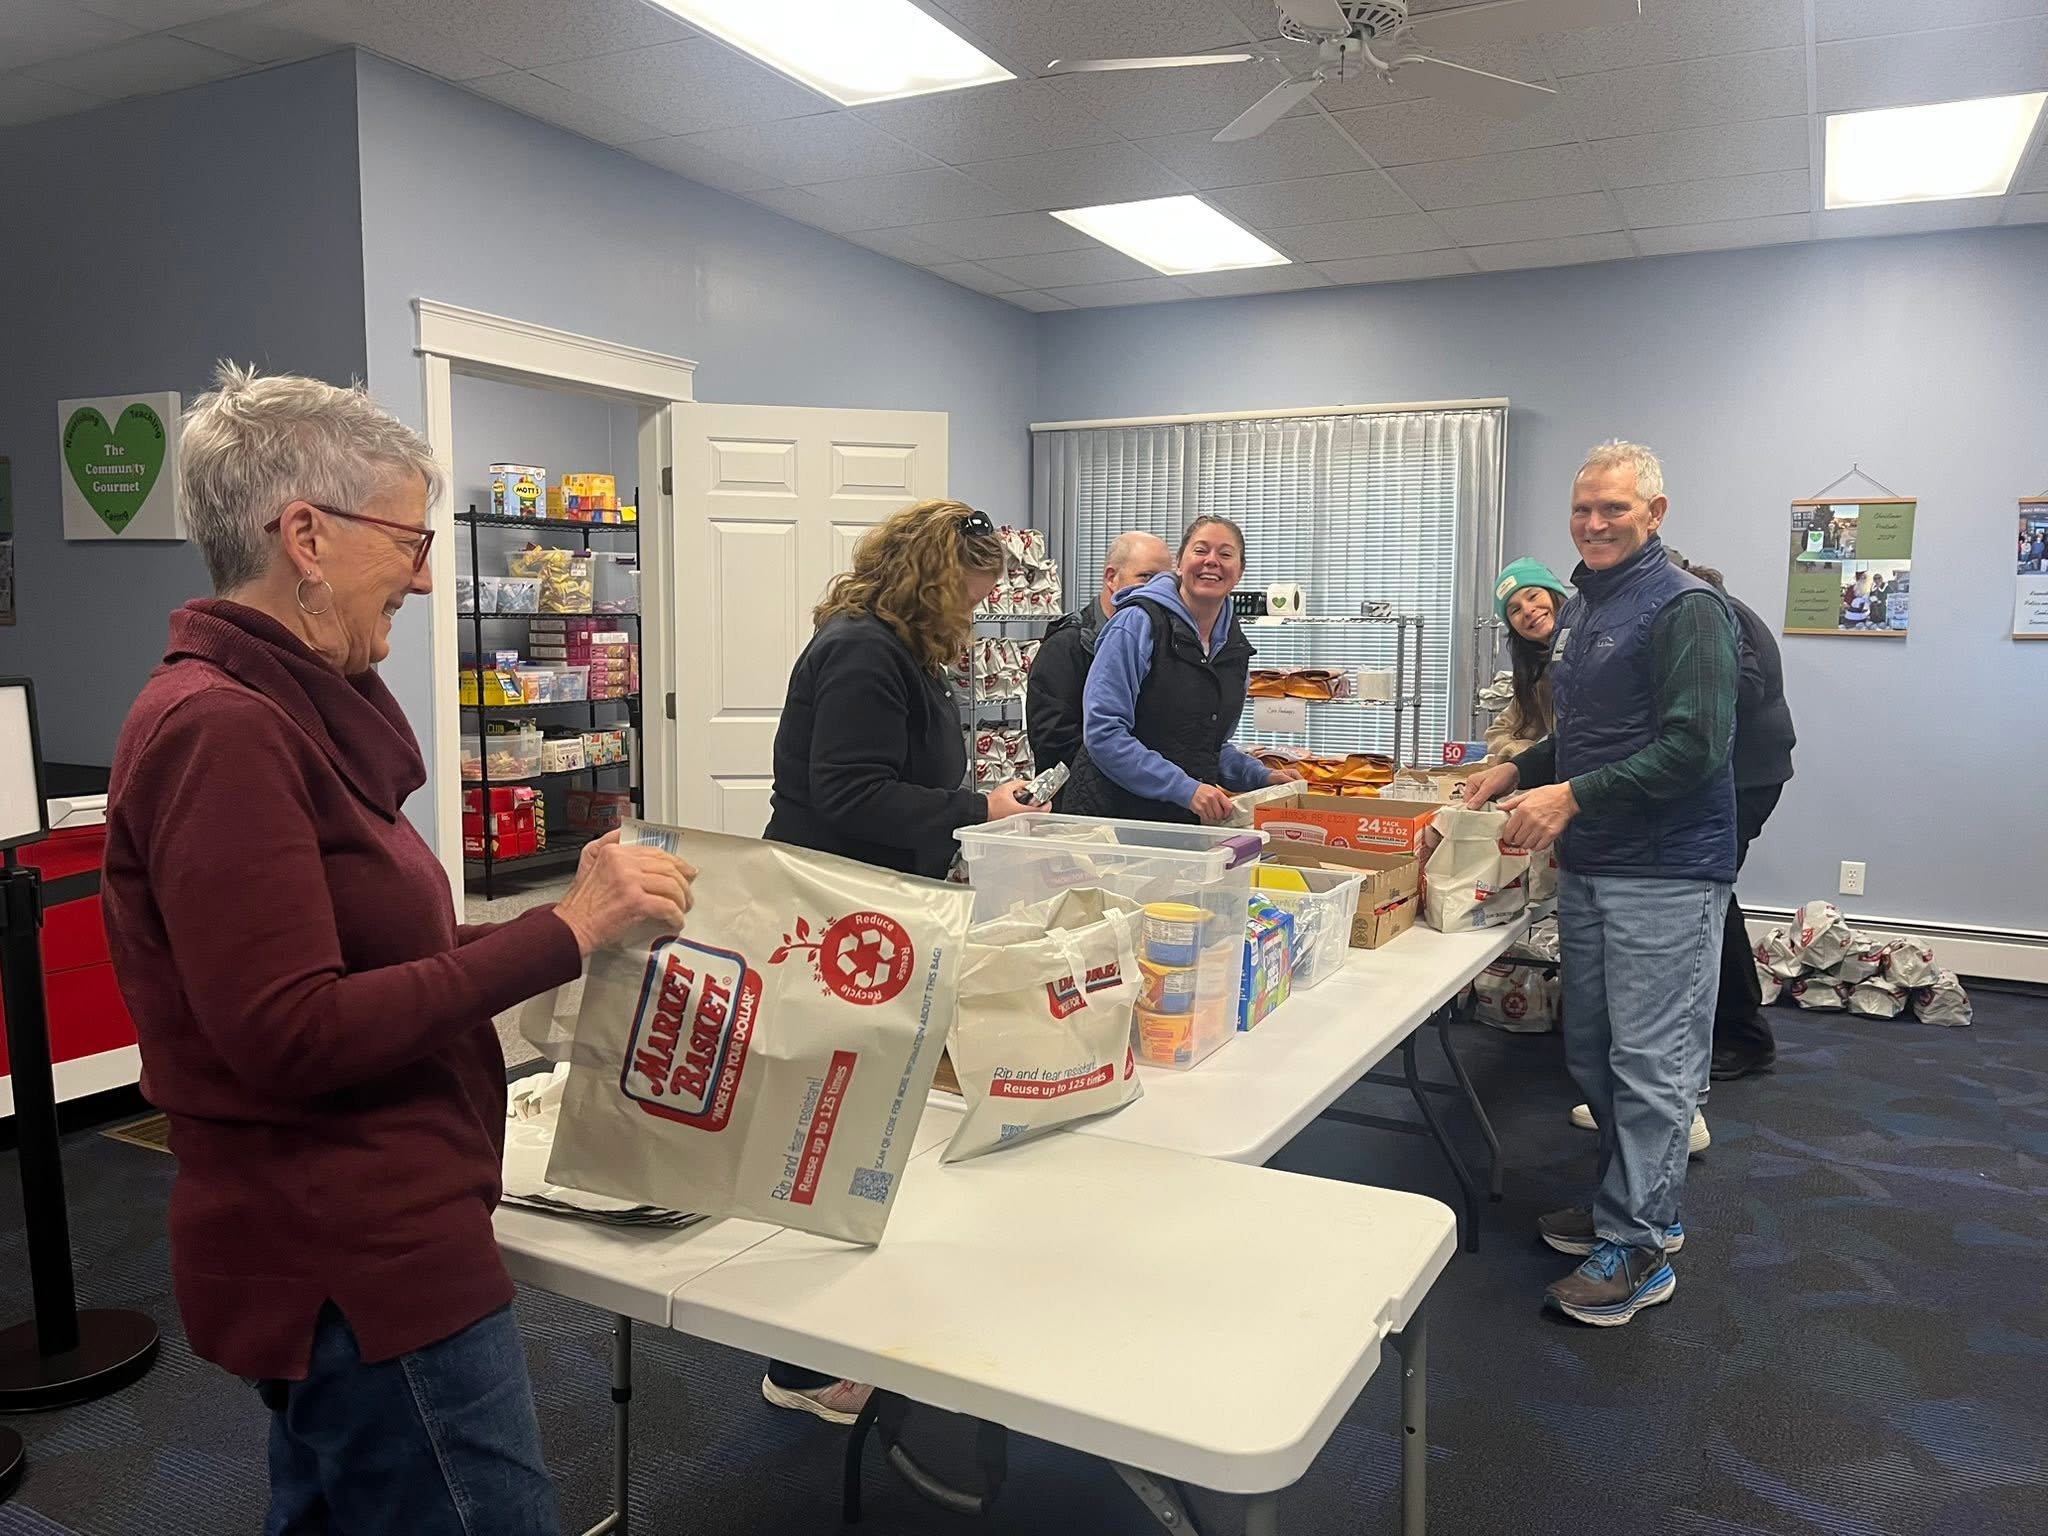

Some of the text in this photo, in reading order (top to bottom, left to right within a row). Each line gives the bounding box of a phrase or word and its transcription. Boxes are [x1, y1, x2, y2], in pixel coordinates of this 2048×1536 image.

[129, 410, 162, 439] Teaching
[104, 444, 125, 456] The
[85, 463, 146, 476] Community
[93, 481, 140, 493] Gourmet
[1445, 746, 1461, 759] 50
[1357, 818, 1381, 833] 24
[1396, 828, 1408, 836] OZ
[855, 914, 894, 932] Reduce
[896, 946, 910, 980] Reuse
[930, 947, 942, 971] BAG!
[841, 984, 882, 1000] Recycle
[926, 972, 937, 992] THIS
[920, 994, 933, 1027] ABOUT
[634, 953, 695, 1096] MARKET
[670, 973, 731, 1101] BASKET
[728, 1040, 744, 1069] YOUR
[721, 1067, 737, 1091] FOR
[994, 1067, 1013, 1081] Rip
[1016, 1067, 1039, 1080] and
[1042, 1070, 1062, 1081] tear
[1003, 1072, 1107, 1097] Reuse up to 125 times
[891, 1099, 903, 1115] FOR
[799, 1065, 848, 1192] Reuse up to 125 times
[885, 1116, 898, 1137] CODE
[881, 1137, 891, 1149] QR
[874, 1150, 887, 1170] SCAN
[771, 1179, 793, 1201] Rip
[783, 1153, 799, 1179] and
